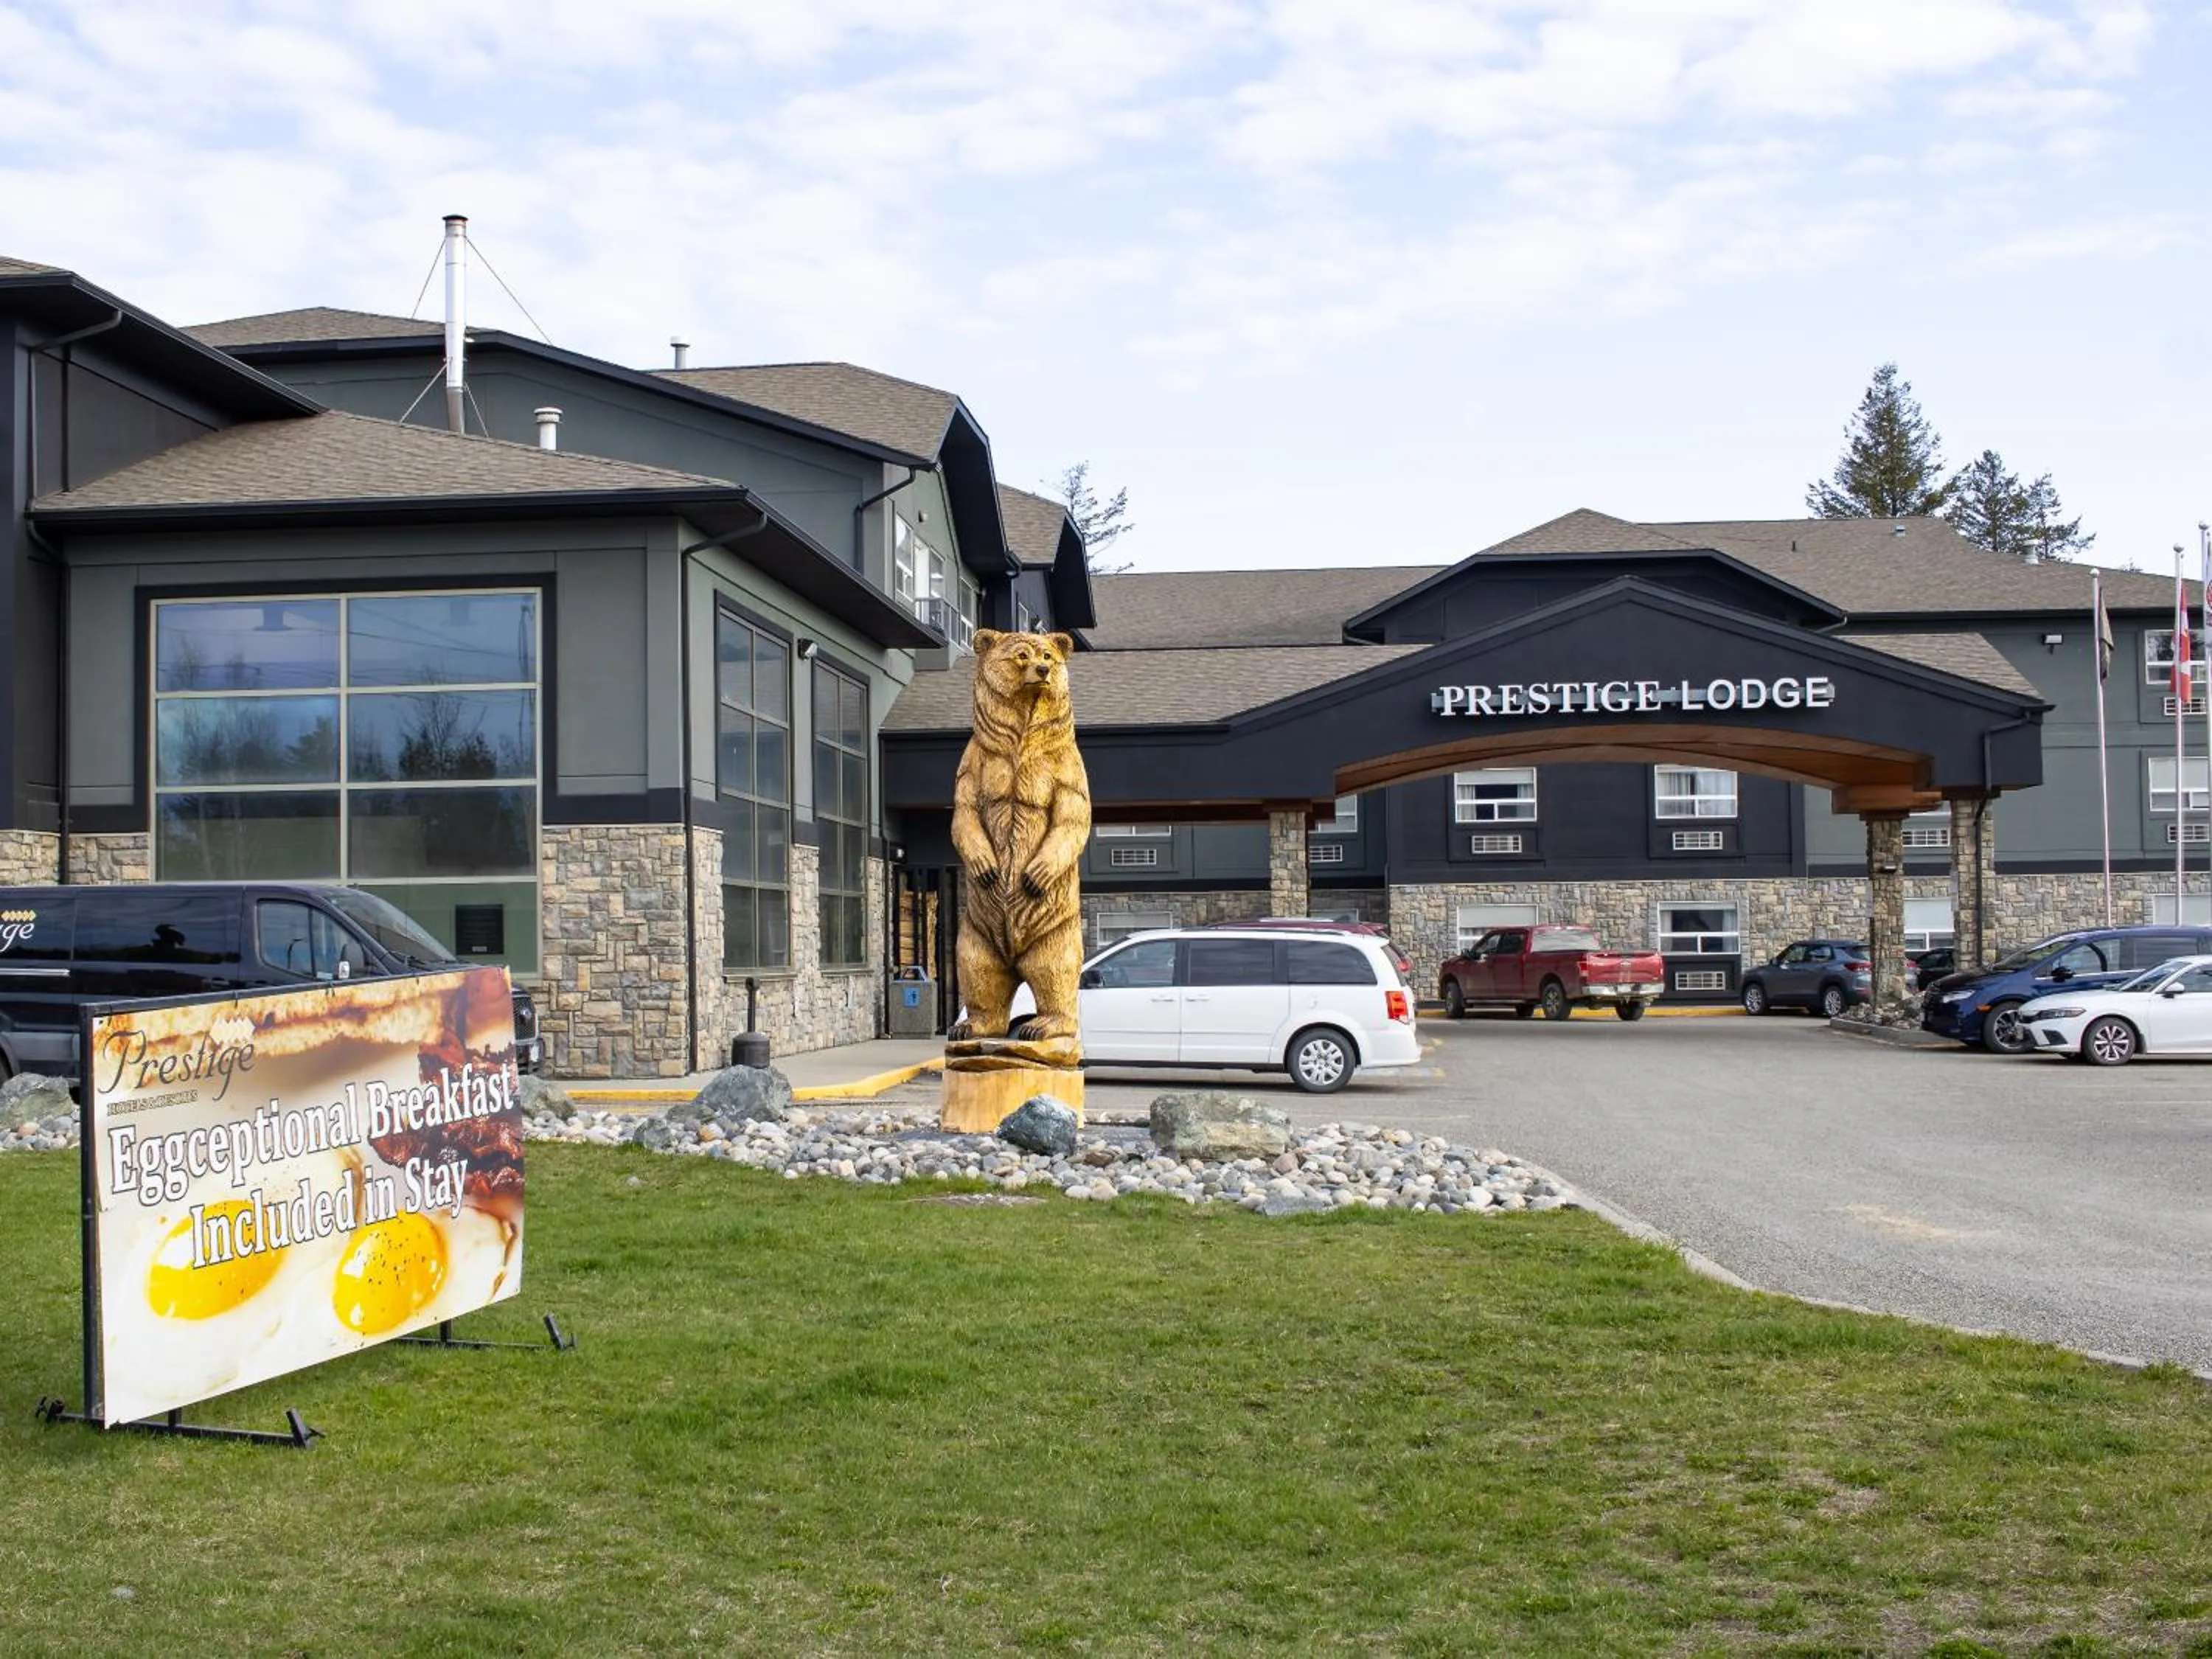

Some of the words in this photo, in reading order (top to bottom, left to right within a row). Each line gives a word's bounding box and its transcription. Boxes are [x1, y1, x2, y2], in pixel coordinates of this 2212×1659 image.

[1439, 680, 1662, 716] PRESTIGE
[1681, 676, 1830, 711] LODGE
[0, 922, 35, 952] ge
[97, 1029, 255, 1101] Prestige
[108, 1084, 361, 1206] Eggceptional
[367, 1062, 515, 1140] Breakfast
[191, 1168, 357, 1270] Included
[364, 1166, 397, 1226] in
[405, 1155, 468, 1219] Stay
